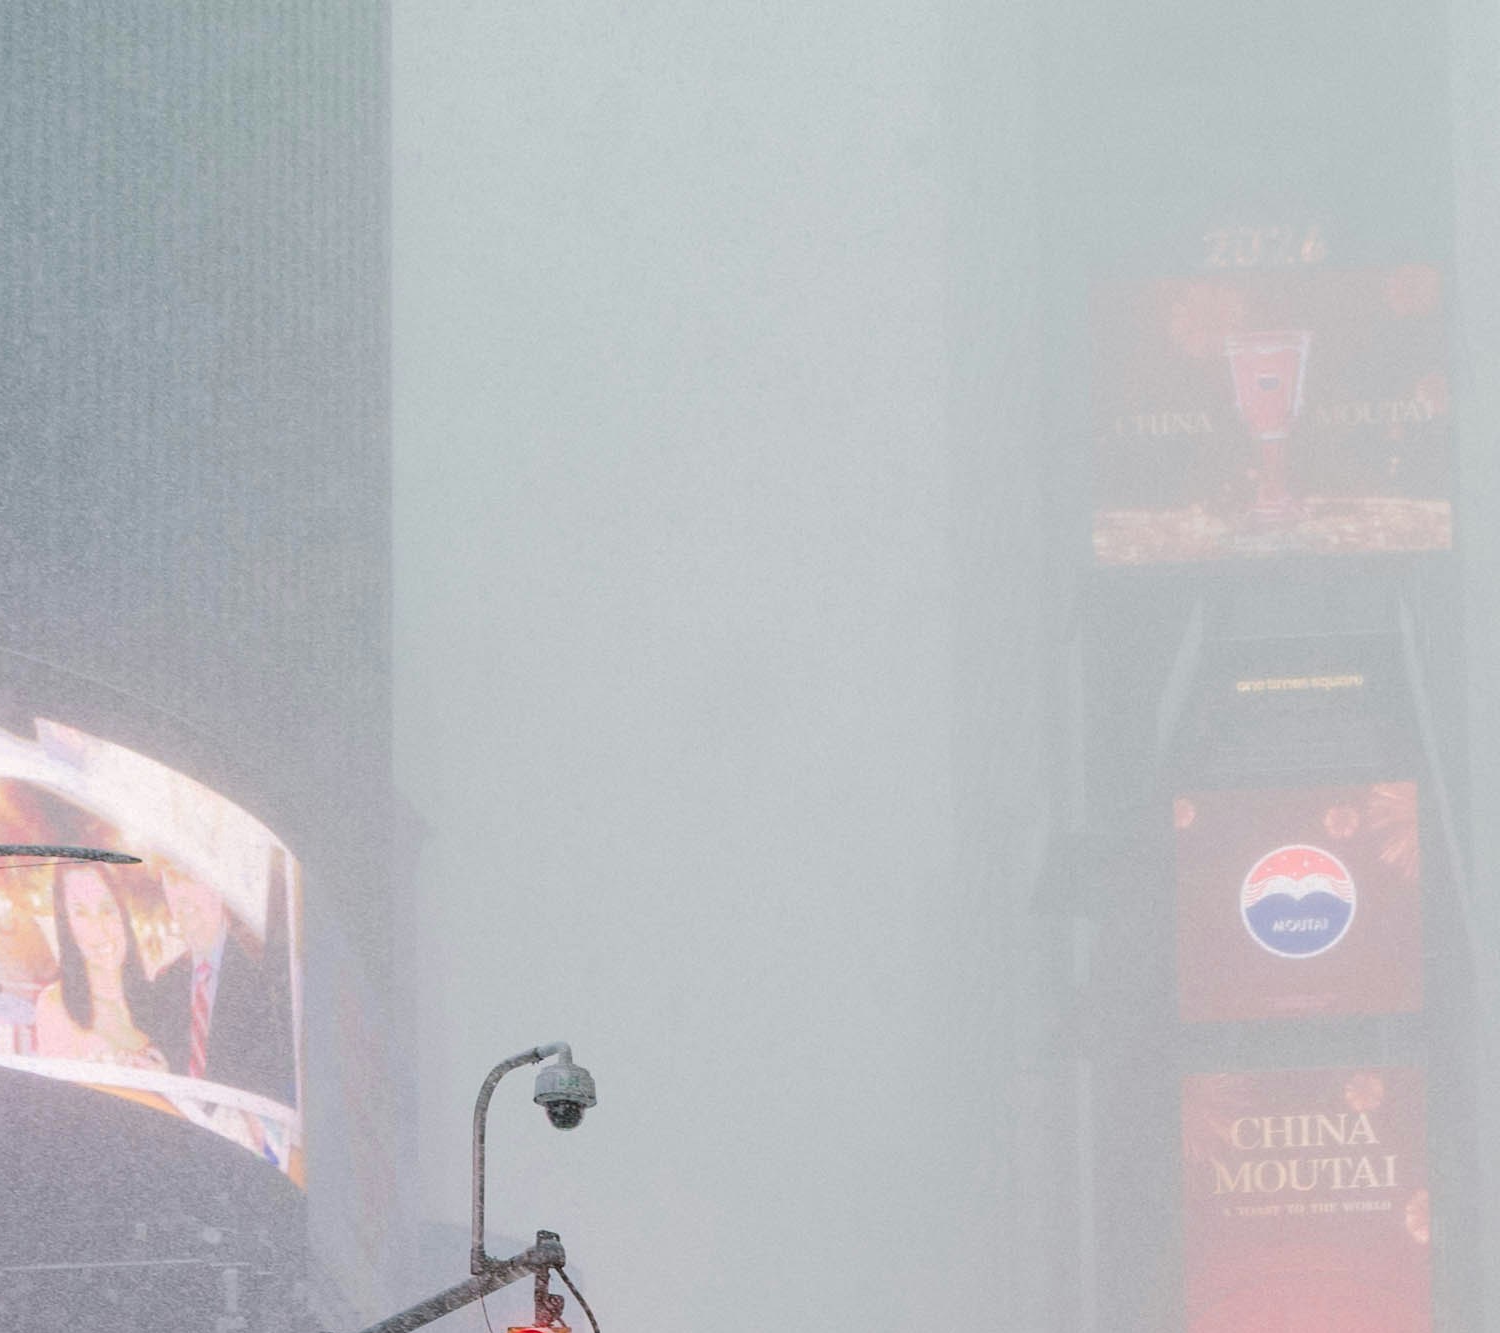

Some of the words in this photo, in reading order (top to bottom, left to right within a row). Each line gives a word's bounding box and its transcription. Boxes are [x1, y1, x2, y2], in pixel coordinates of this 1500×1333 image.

[1272, 916, 1330, 933] MOUTAI
[1231, 1110, 1381, 1151] CHINA
[1212, 1153, 1399, 1196] MOUTAI
[1287, 1203, 1306, 1214] TO
[1311, 1201, 1338, 1213] THE
[1343, 1199, 1393, 1212] WORLD
